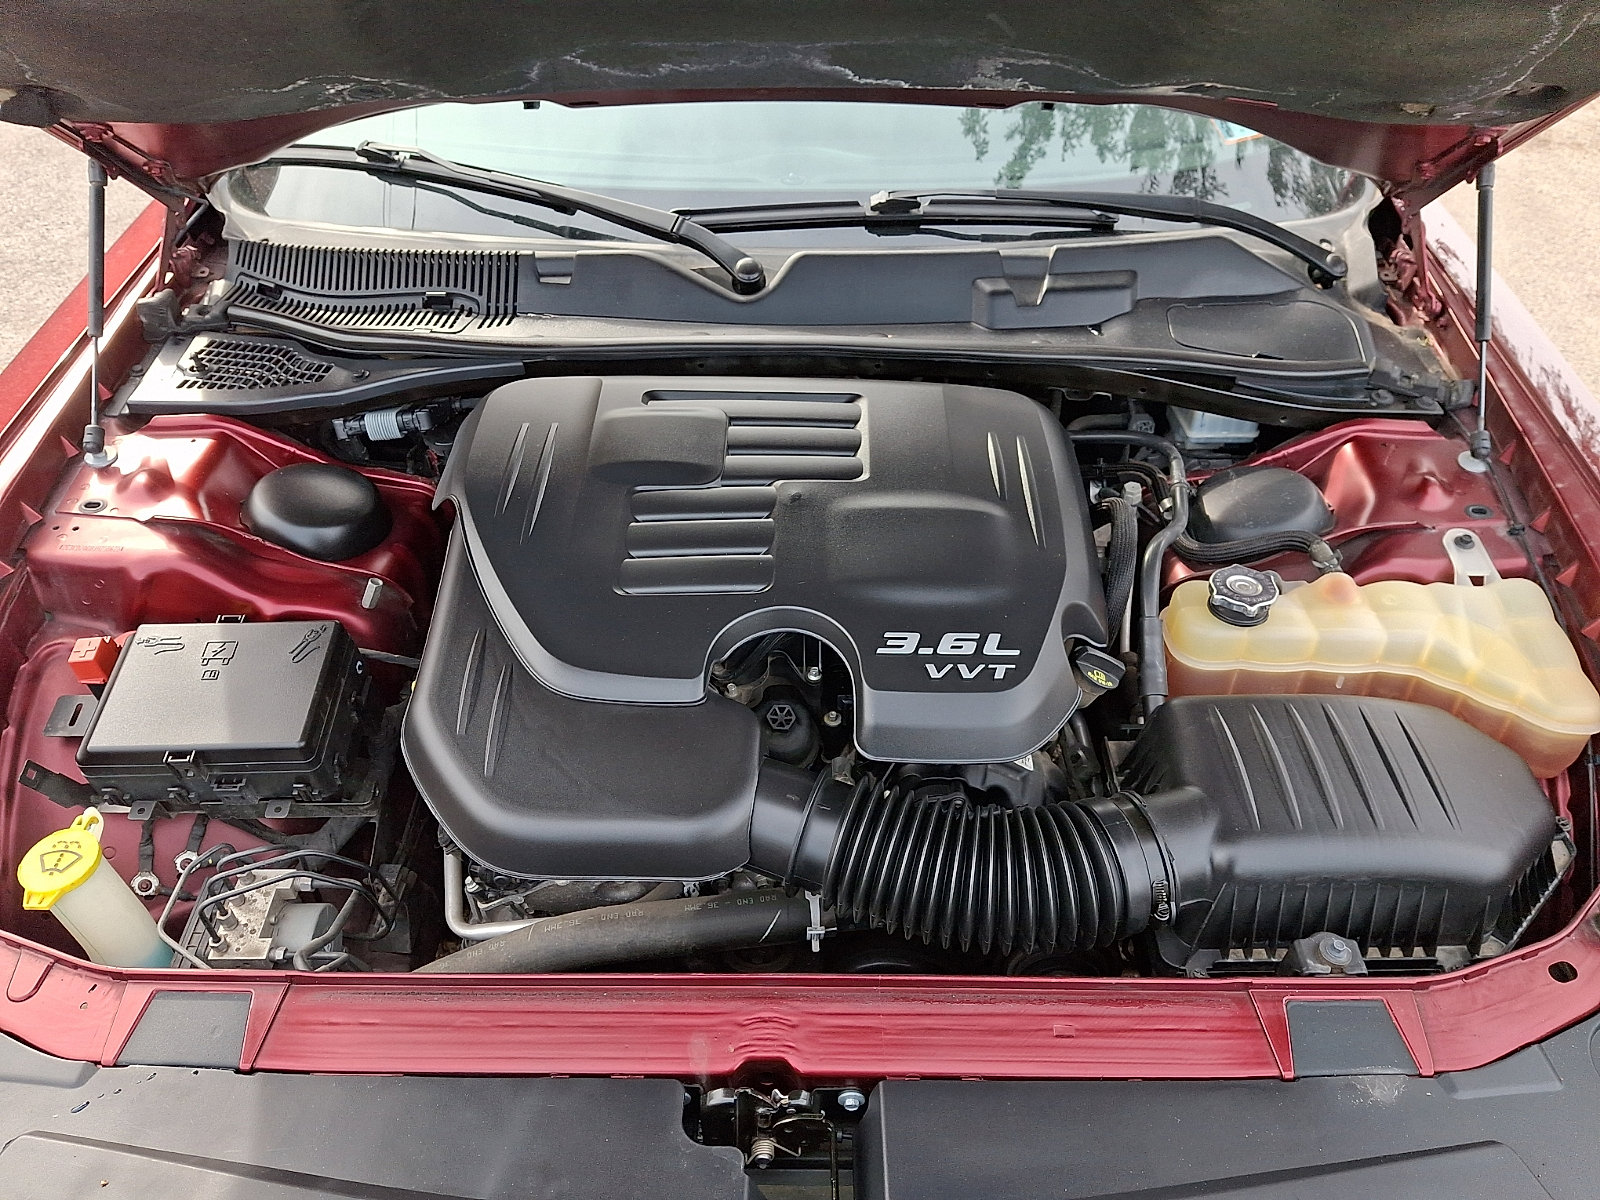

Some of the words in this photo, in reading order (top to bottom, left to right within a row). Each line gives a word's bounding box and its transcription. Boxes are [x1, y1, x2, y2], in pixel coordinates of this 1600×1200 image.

[876, 631, 1021, 656] 3.6L
[924, 663, 1017, 681] VVT
[736, 897, 754, 906] END
[759, 894, 777, 903] RAD
[684, 901, 720, 912] 36.3MM
[600, 912, 619, 921] END
